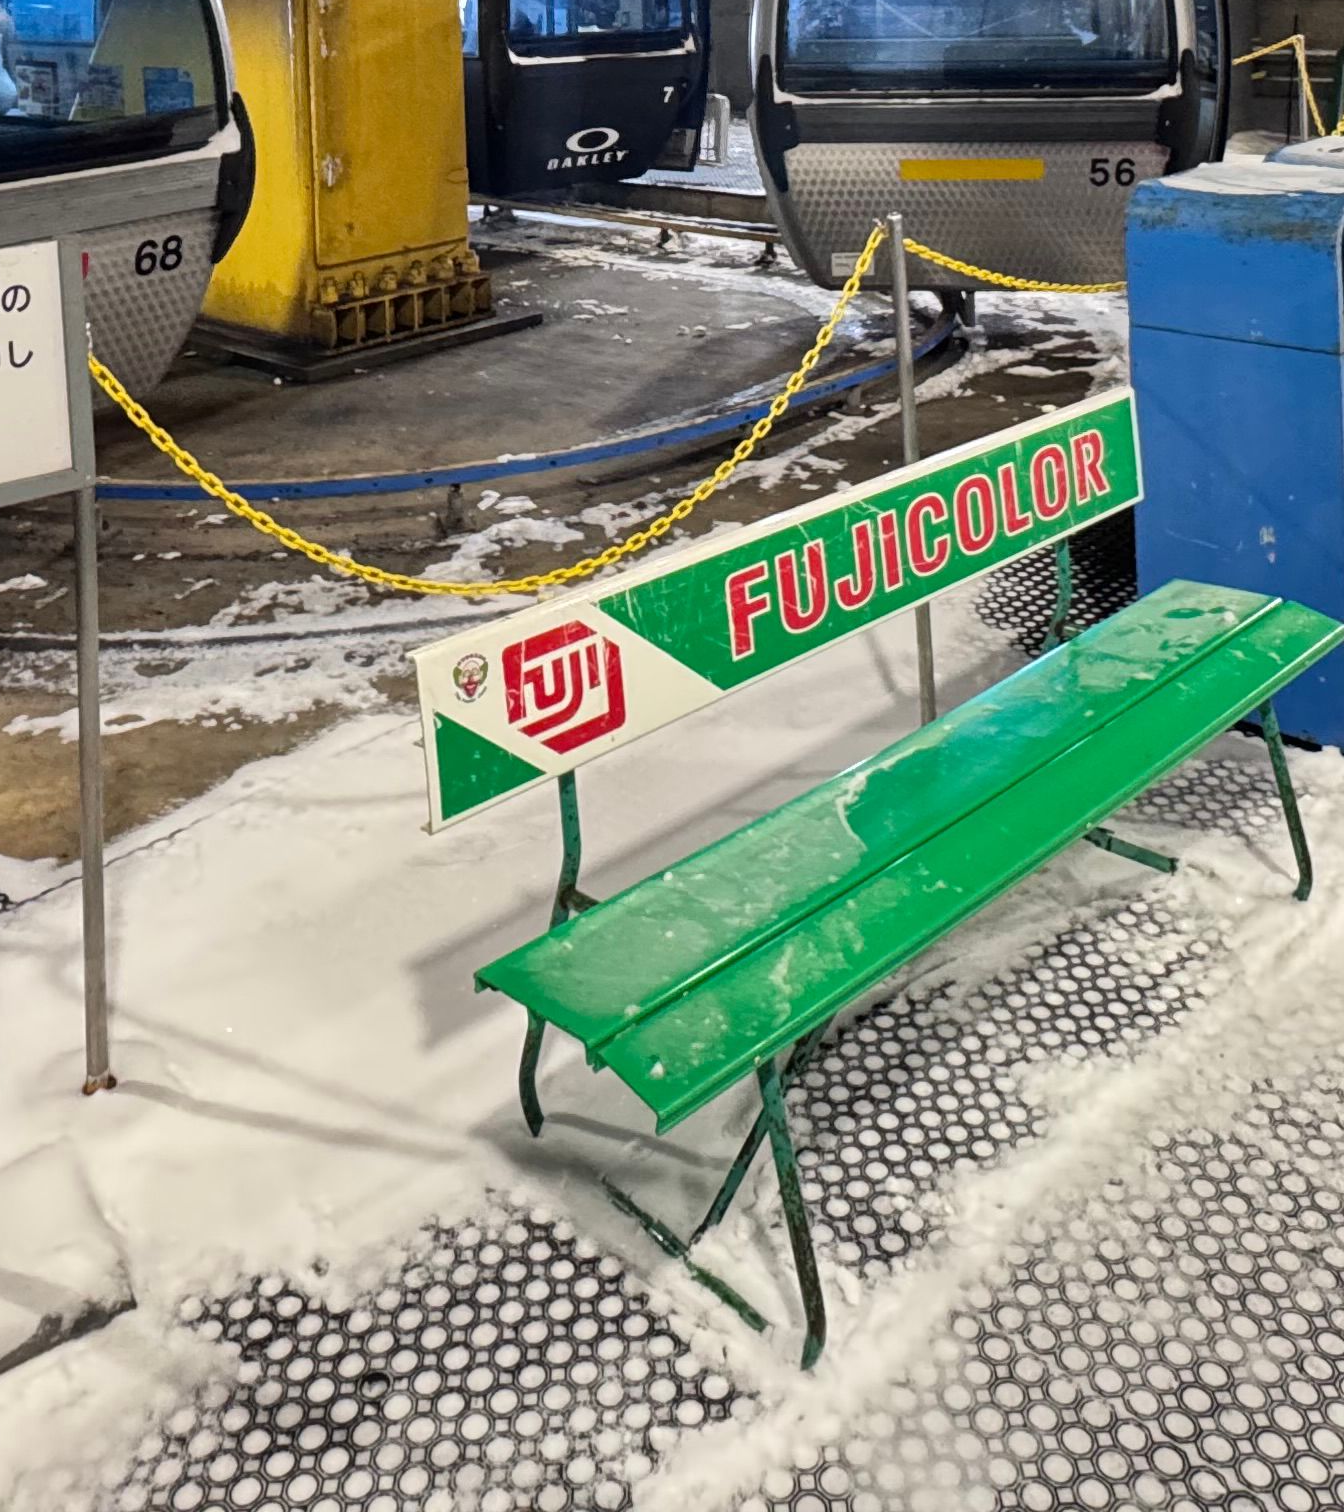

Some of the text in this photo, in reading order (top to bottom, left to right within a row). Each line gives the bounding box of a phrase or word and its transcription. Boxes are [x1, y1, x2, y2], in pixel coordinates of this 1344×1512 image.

[663, 86, 674, 103] 7
[546, 149, 630, 171] OAKLEY
[1089, 158, 1136, 187] 56
[135, 235, 182, 276] 68
[724, 428, 1112, 663] FUJICOLOR
[502, 620, 626, 755] FUJI
